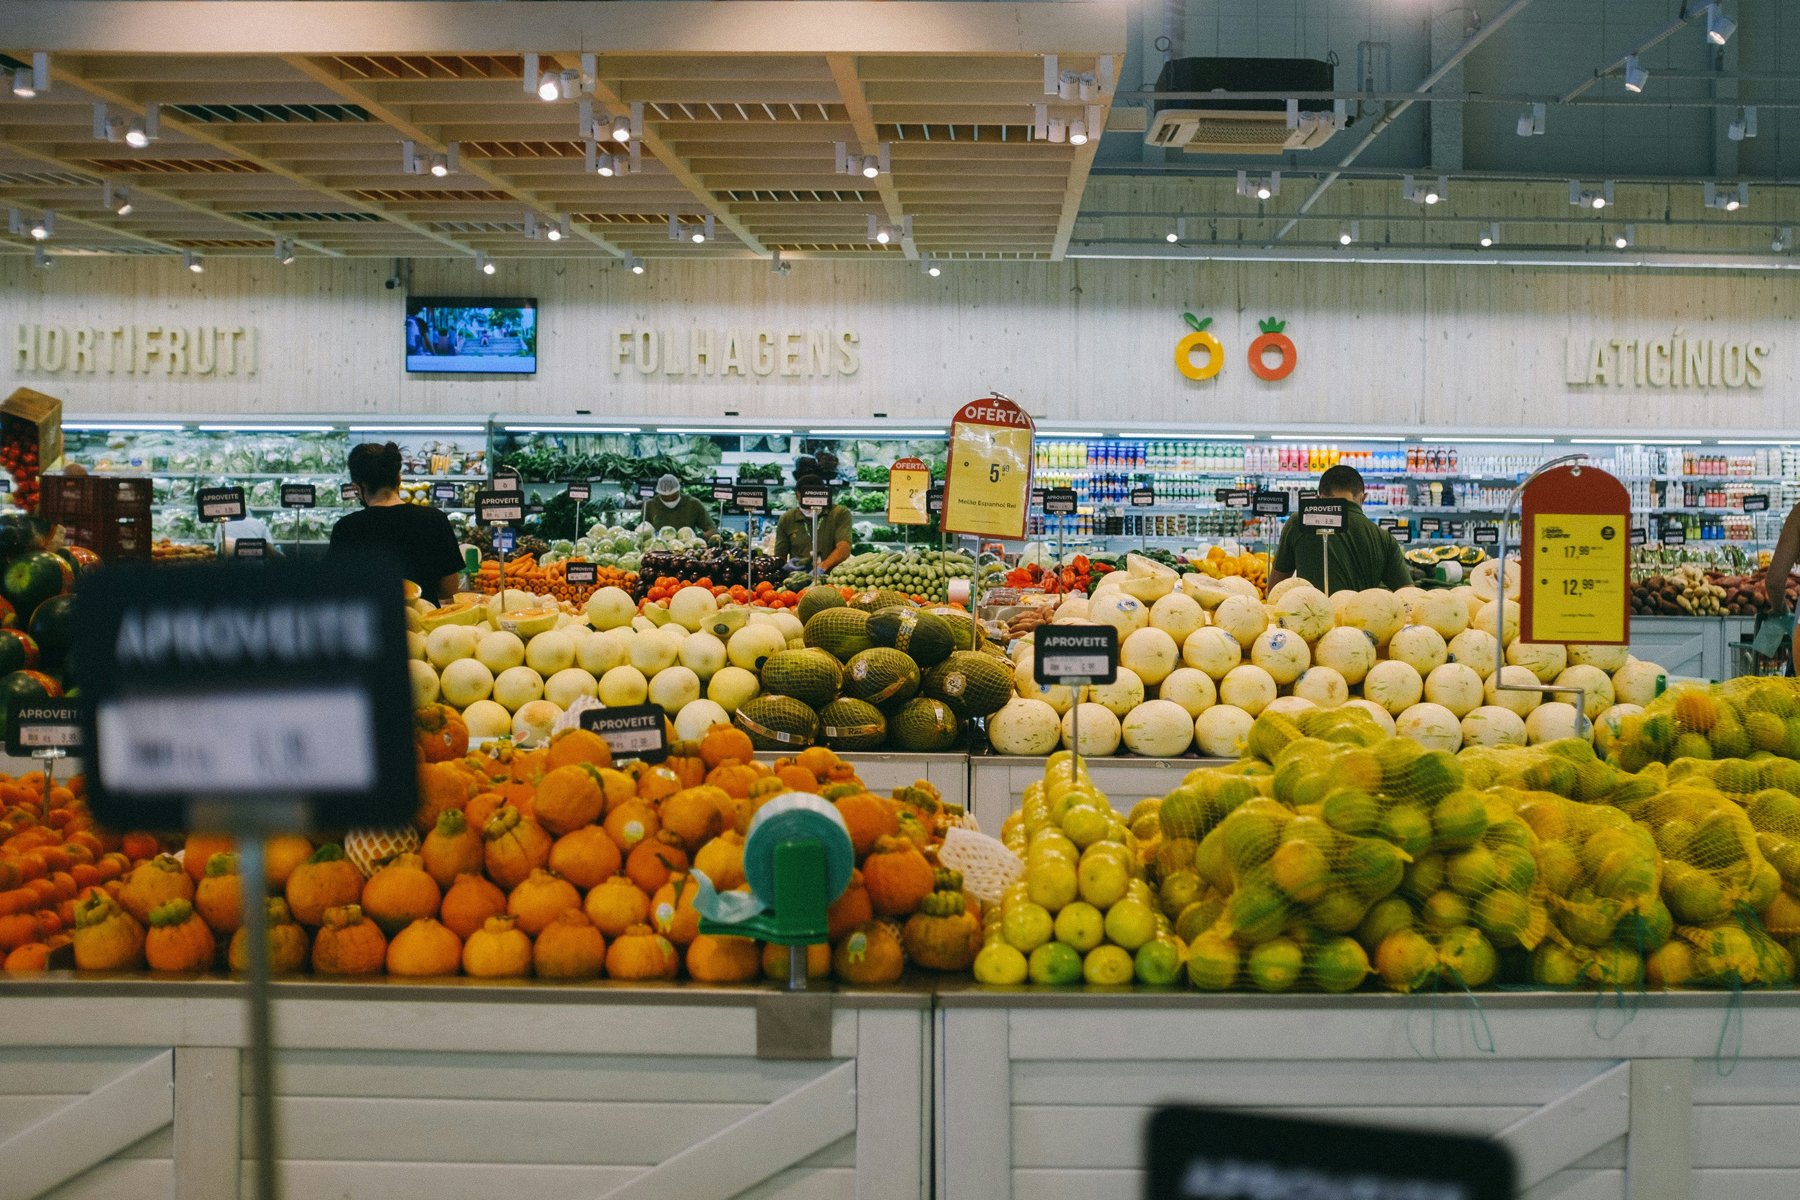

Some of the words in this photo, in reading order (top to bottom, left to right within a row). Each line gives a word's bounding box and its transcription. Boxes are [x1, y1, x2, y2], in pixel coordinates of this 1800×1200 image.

[13, 323, 259, 376] HORTIFRUTI
[610, 327, 861, 378] FOLHAGENS
[1565, 326, 1773, 389] LATICÍNIOS
[964, 405, 1027, 425] OFERTA
[895, 462, 926, 470] OFERTA
[203, 493, 238, 501] APROVEITE
[481, 497, 520, 505] APROVEITE
[1304, 505, 1342, 513] APROVEITE
[1043, 636, 1109, 648] APROVEITE
[18, 709, 79, 720] APROVEIT
[591, 715, 656, 731] APROVEITE
